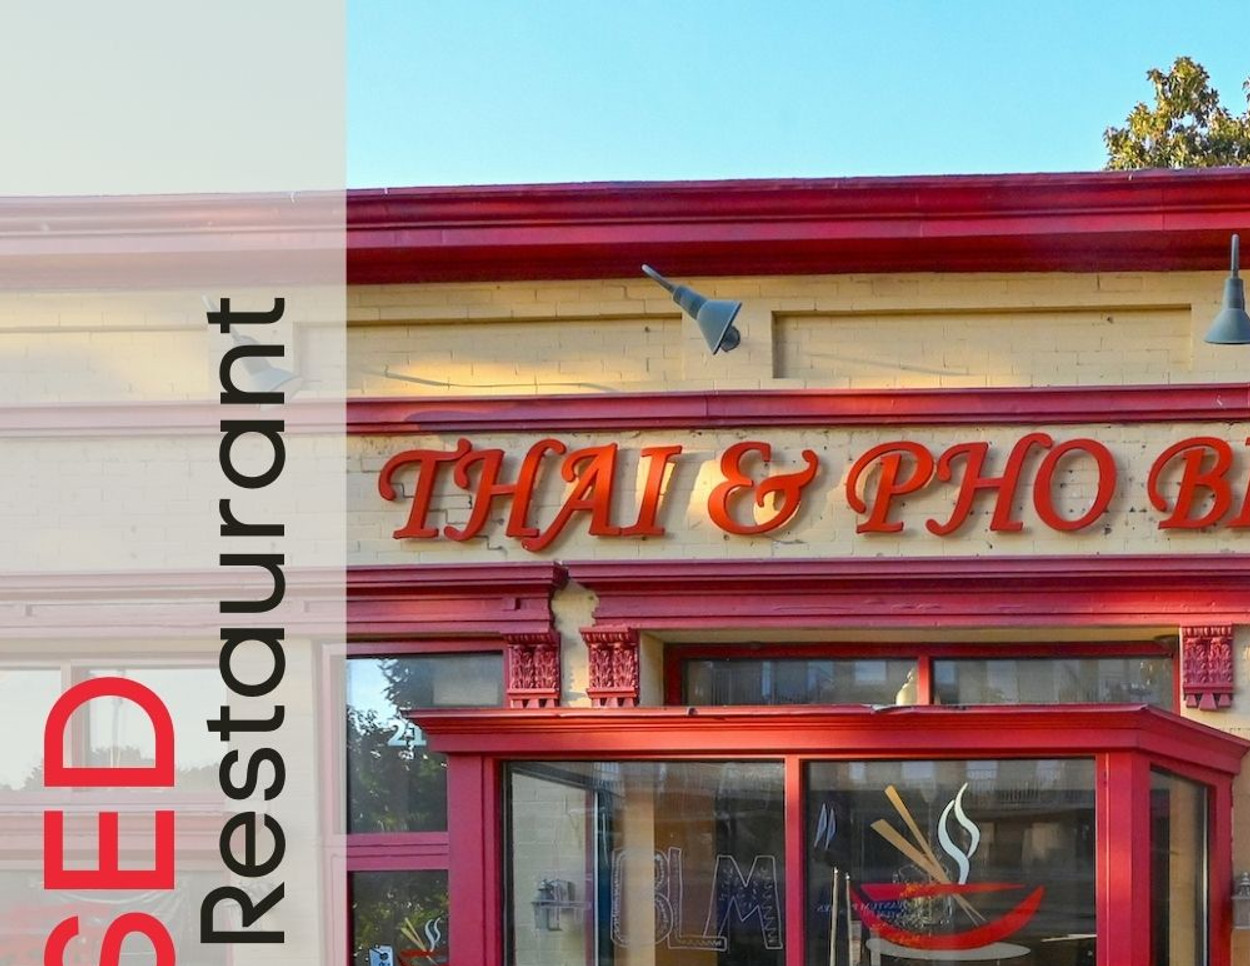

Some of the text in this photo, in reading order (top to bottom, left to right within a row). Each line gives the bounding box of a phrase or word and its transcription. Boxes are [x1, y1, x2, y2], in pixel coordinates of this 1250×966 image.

[379, 438, 682, 551] THAI
[707, 441, 819, 535] &
[845, 432, 1117, 536] PHO
